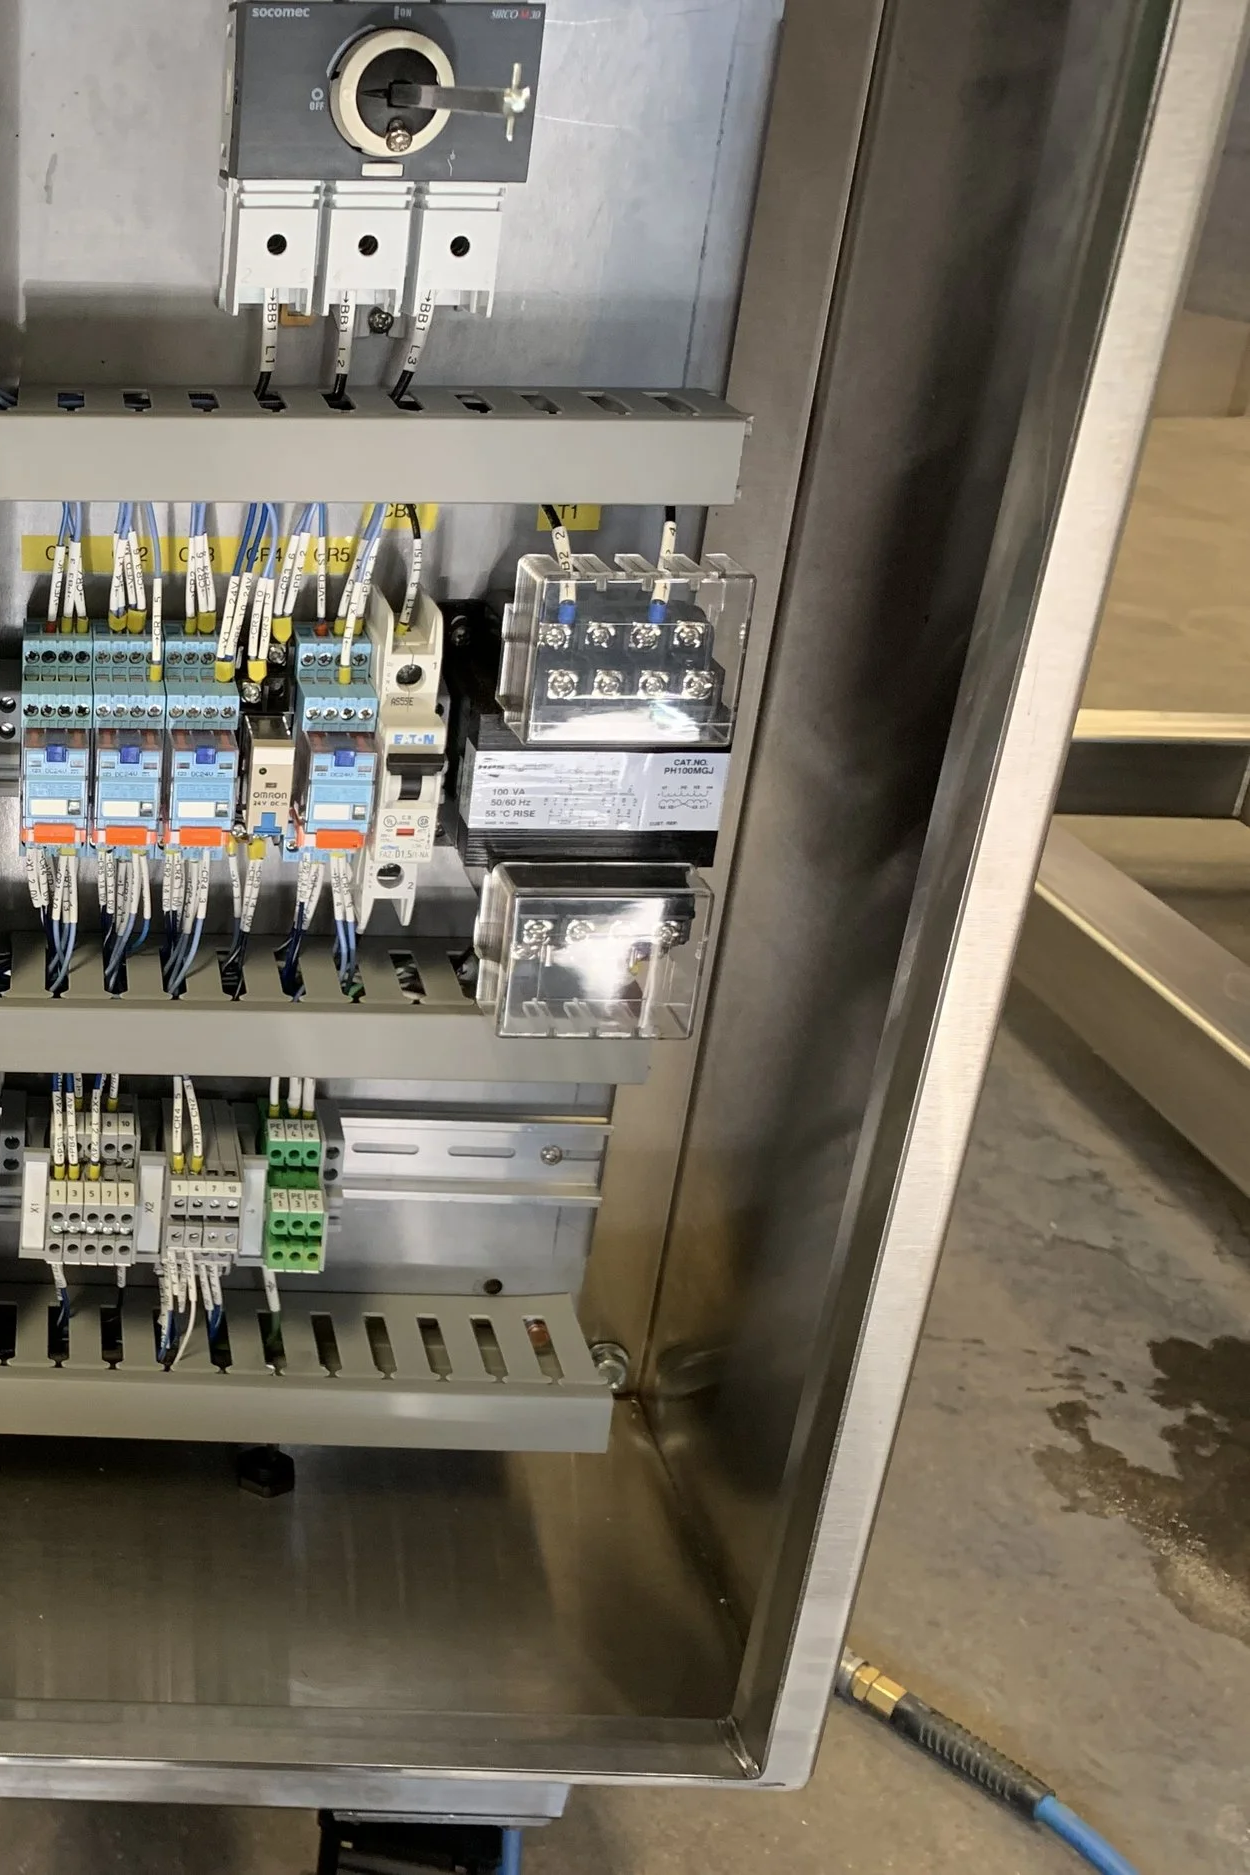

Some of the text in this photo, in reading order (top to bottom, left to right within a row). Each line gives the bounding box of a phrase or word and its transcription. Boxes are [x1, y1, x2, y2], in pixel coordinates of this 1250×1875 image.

[252, 7, 310, 18] socomec
[399, 8, 412, 17] ON
[309, 102, 325, 111] OFF
[265, 302, 278, 365] BB1 L1
[337, 304, 350, 368] BB1 L2
[407, 303, 432, 365] BB1 L3
[558, 504, 577, 519] T1
[555, 531, 565, 540] 2
[229, 582, 239, 604] 24V
[251, 591, 264, 638] CR3 10
[30, 1202, 39, 1213] X1
[145, 1202, 154, 1213] X2
